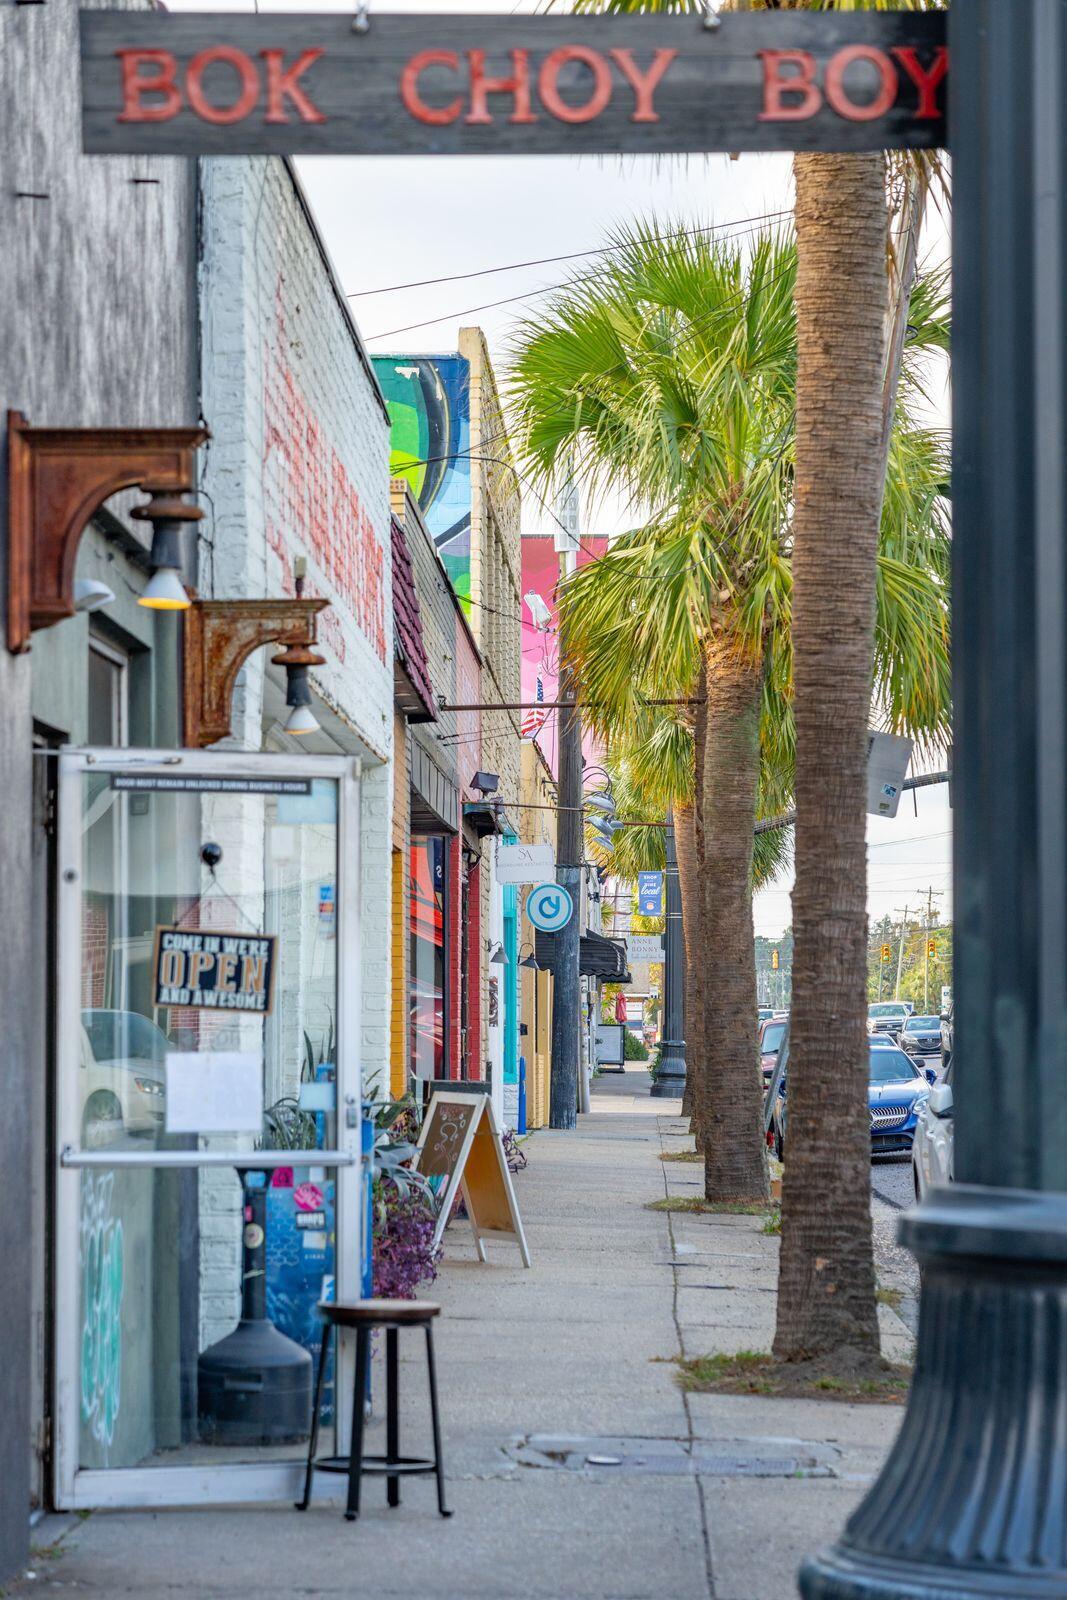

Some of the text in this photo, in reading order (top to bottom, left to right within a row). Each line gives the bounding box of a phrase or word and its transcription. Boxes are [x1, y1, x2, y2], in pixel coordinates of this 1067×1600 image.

[115, 44, 948, 125] BOK CHOY BOY
[640, 884, 661, 895] local
[162, 933, 203, 952] COME
[204, 936, 220, 952] IN
[160, 950, 268, 994] OPEN
[159, 987, 266, 1010] AND AWESOME
